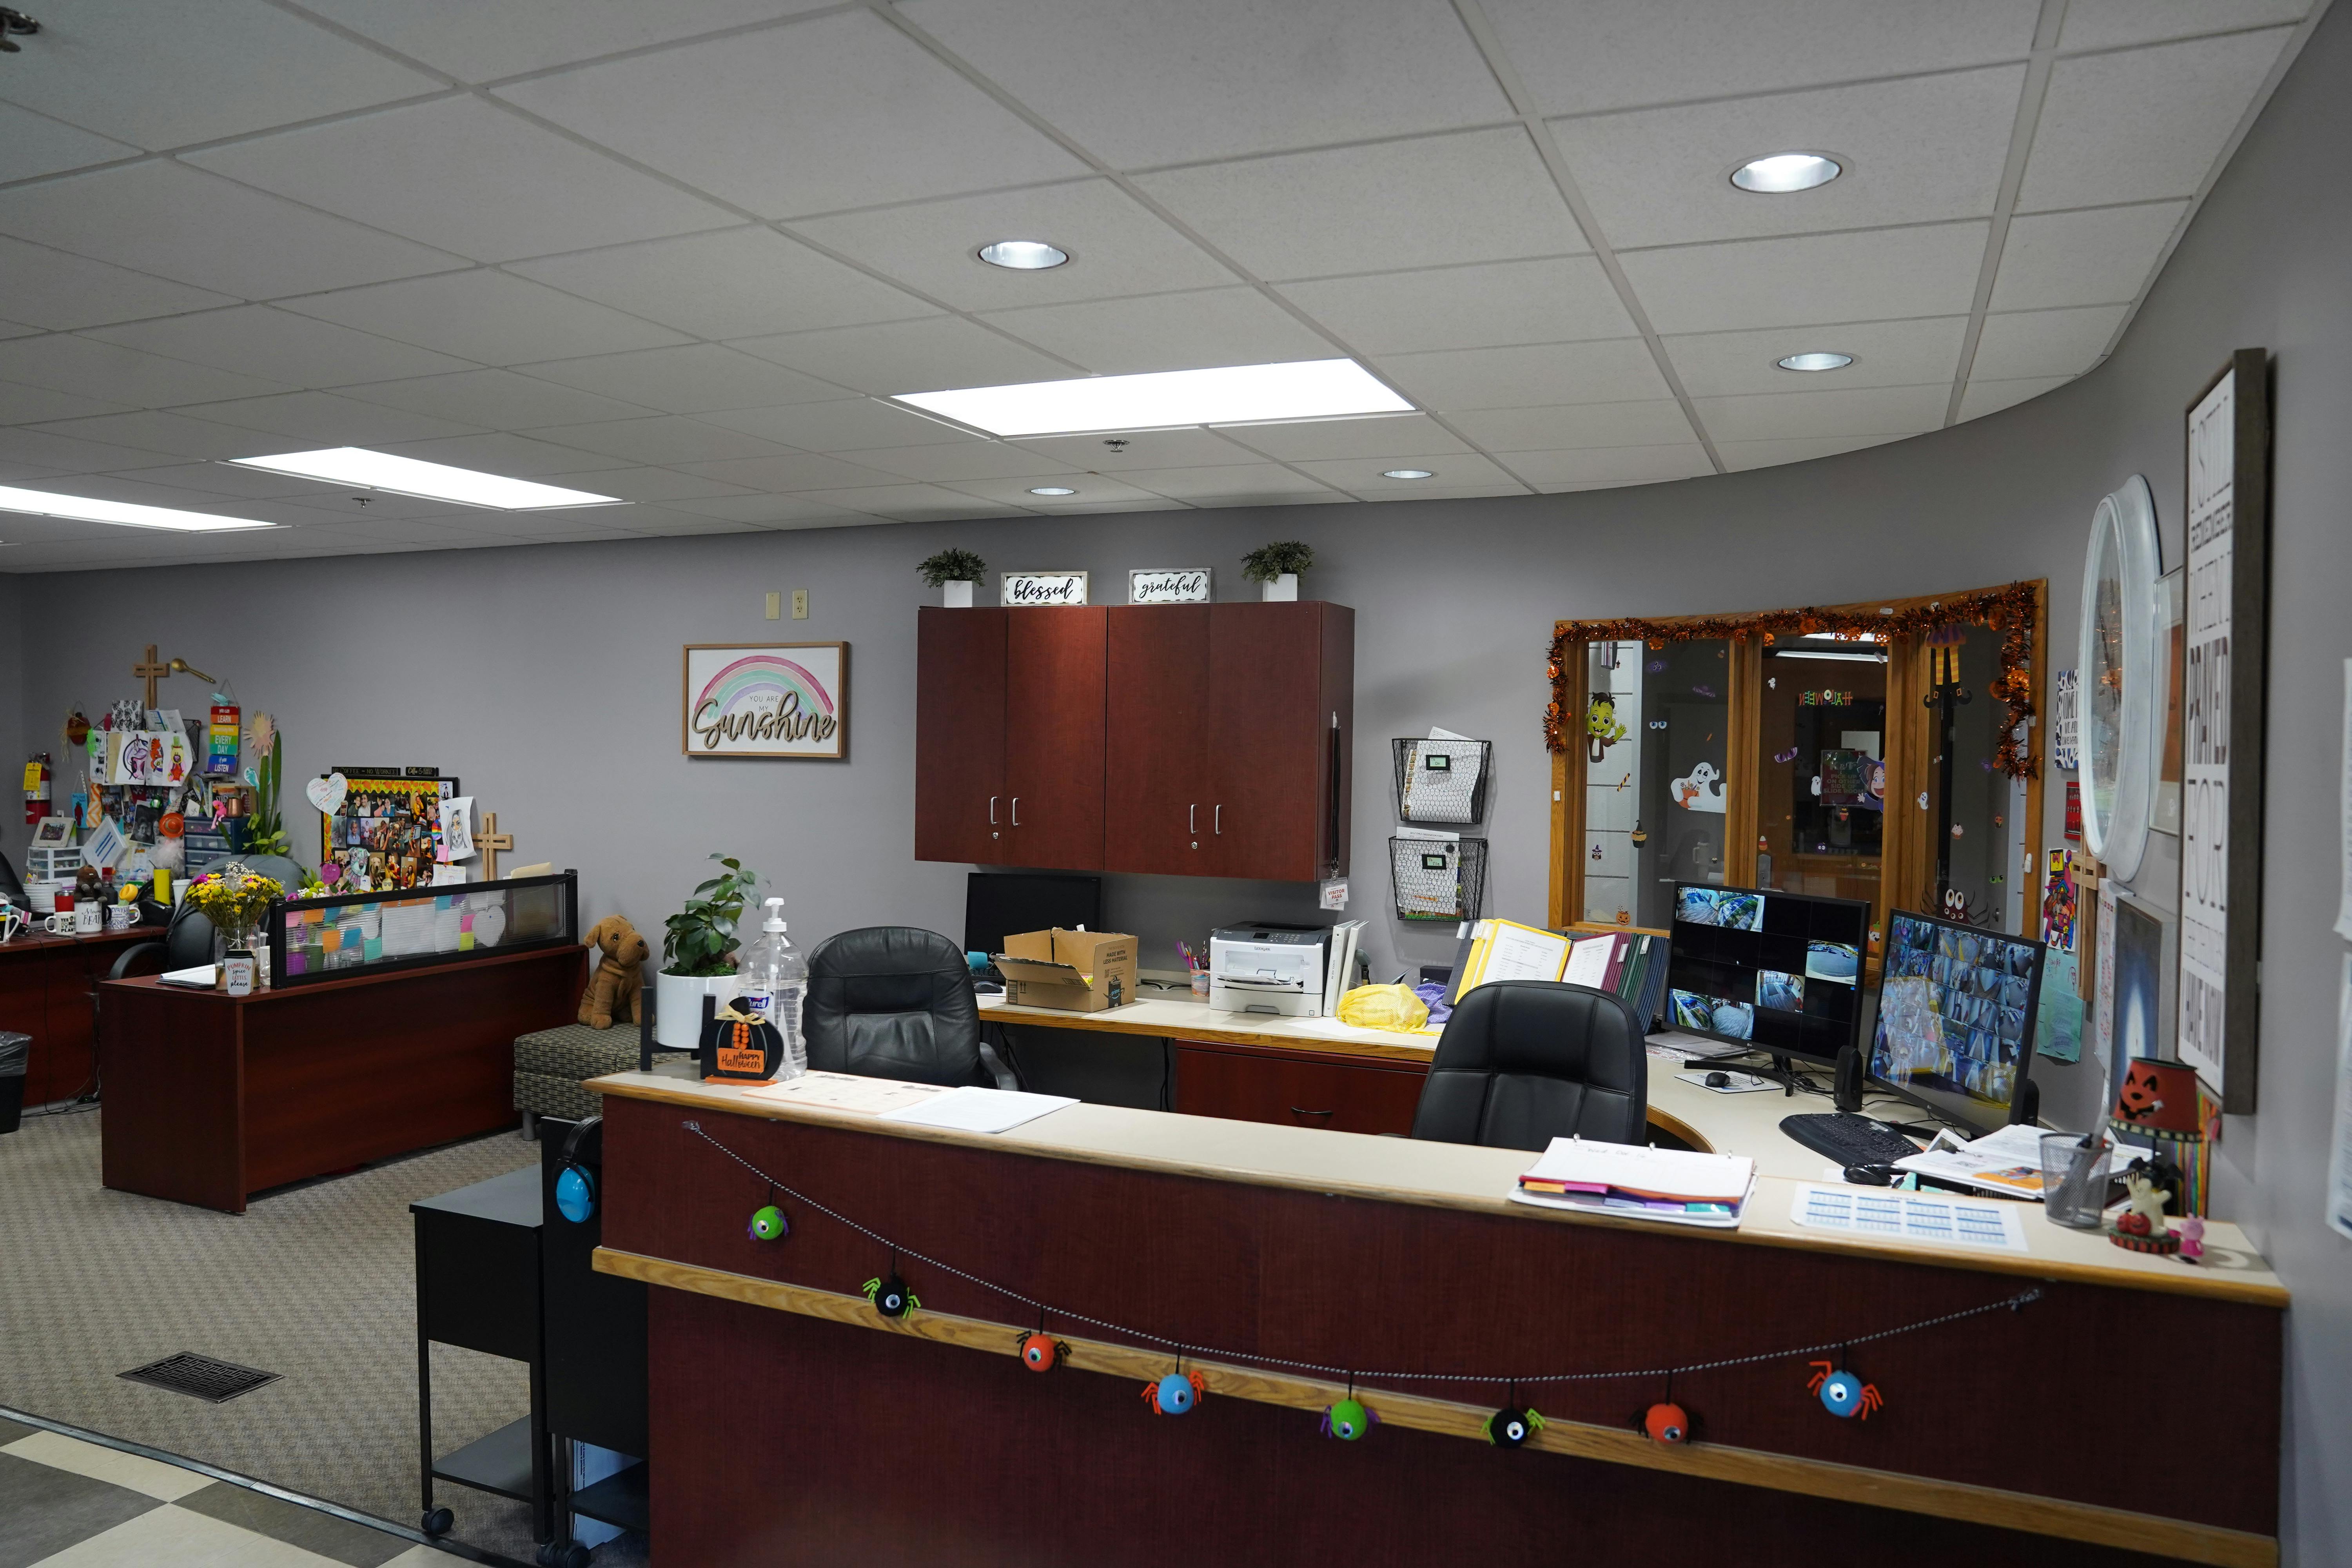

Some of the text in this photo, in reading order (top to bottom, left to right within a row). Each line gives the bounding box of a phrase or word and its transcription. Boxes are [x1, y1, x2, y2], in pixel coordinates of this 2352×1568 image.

[2198, 396, 2232, 508] STILL
[1014, 578, 1073, 599] blessed
[1139, 575, 1201, 599] grateful
[2063, 691, 2074, 719] COME
[2188, 638, 2228, 764] PRAYED
[692, 691, 837, 749] Sunshine
[2065, 721, 2070, 734] WE
[215, 735, 232, 744] EVERY
[218, 745, 228, 754] DAY
[214, 764, 229, 772] LISTEN
[2185, 778, 2225, 913] FOR
[227, 962, 251, 971] PUMPKIN
[722, 1054, 760, 1069] Halloween
